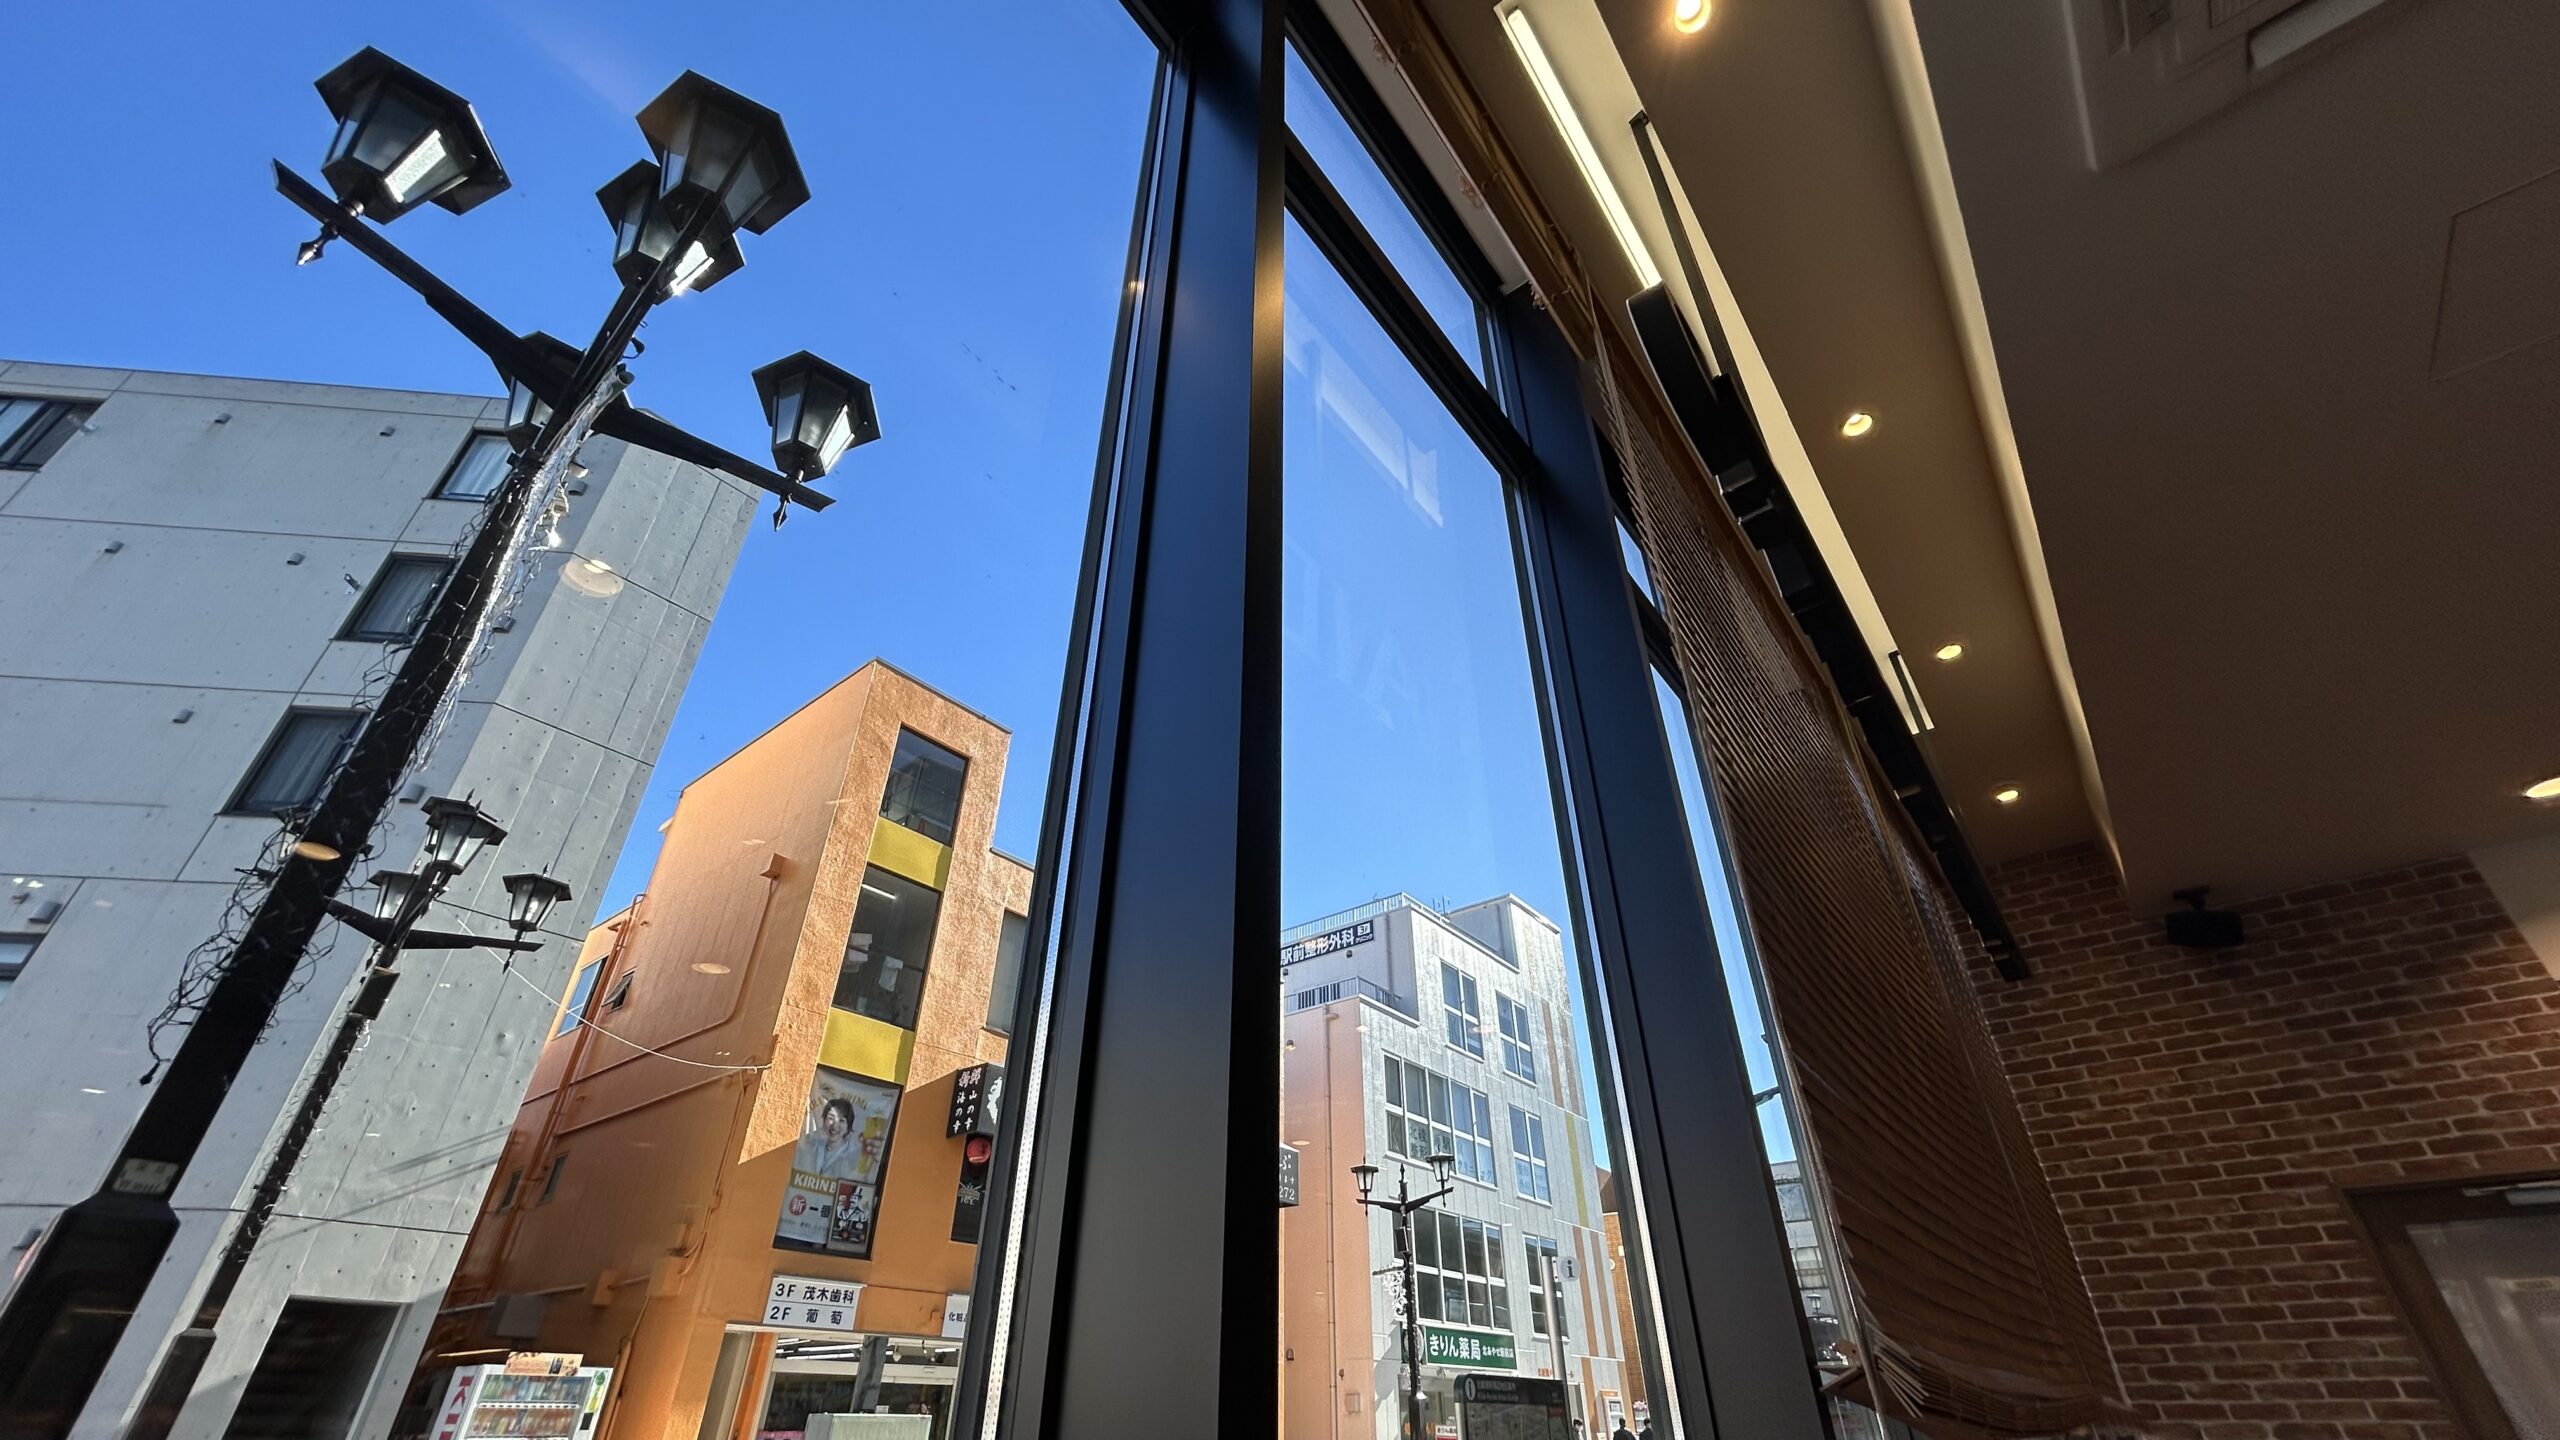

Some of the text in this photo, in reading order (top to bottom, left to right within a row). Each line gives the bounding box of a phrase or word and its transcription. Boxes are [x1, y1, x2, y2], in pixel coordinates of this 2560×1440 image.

[794, 1173, 829, 1192] KIRIN
[775, 1283, 854, 1304] 3F 茂木歯科
[769, 1306, 792, 1320] 2F
[1429, 1333, 1481, 1360] きりん薬局
